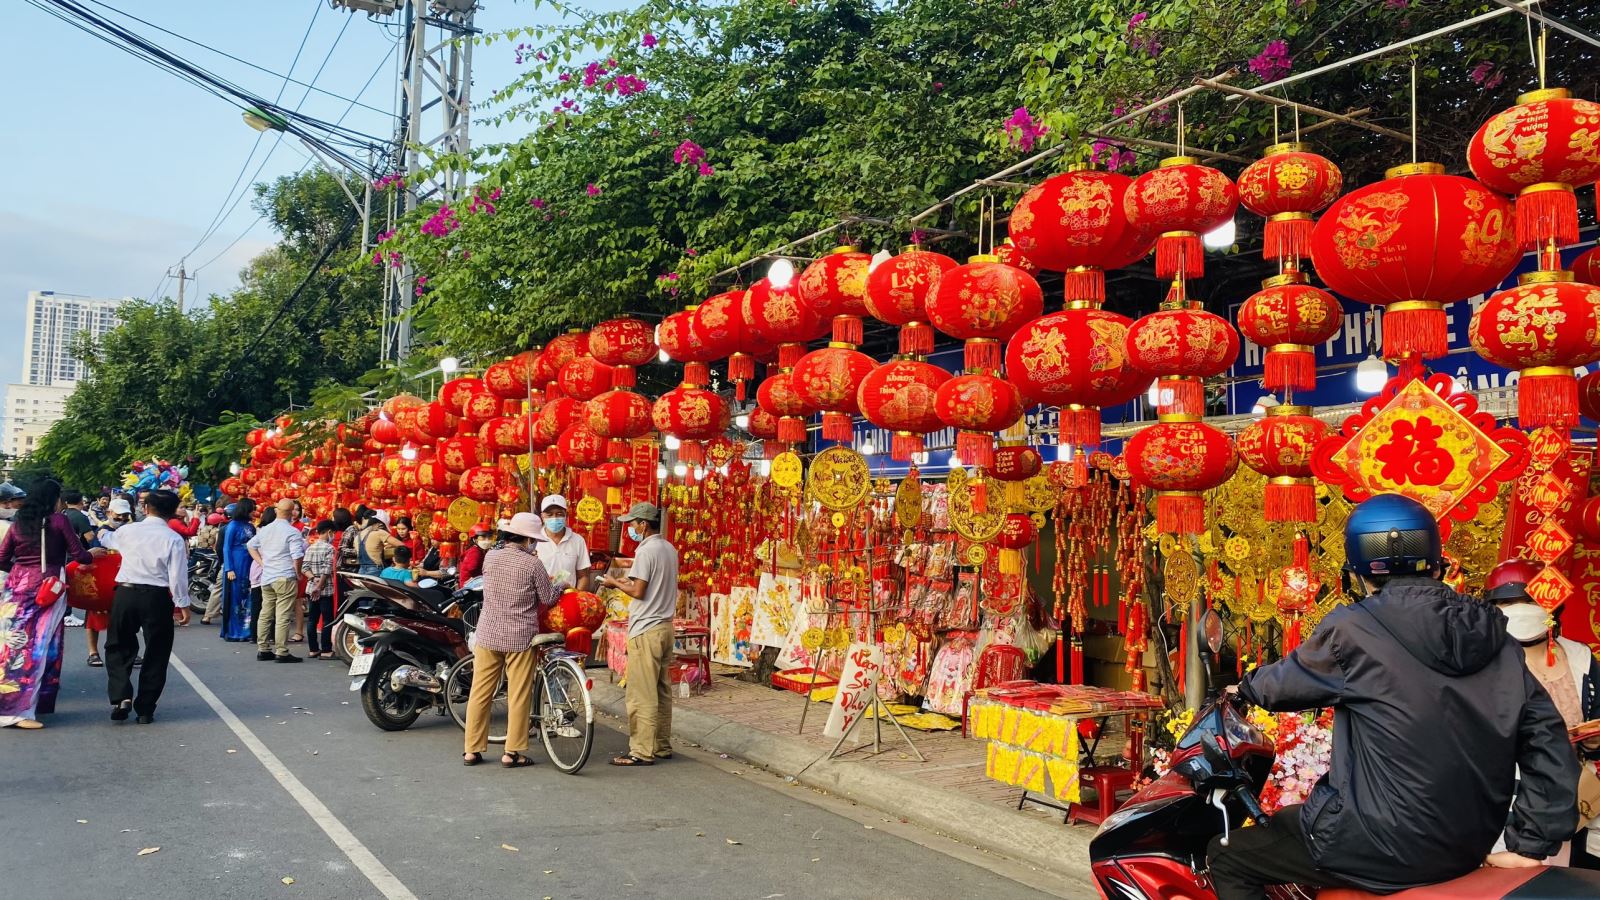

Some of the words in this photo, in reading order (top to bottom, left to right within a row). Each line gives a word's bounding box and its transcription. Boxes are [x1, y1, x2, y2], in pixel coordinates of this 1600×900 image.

[1521, 122, 1549, 132] vượng
[1526, 114, 1549, 123] thịnh
[891, 271, 926, 290] Lộc
[620, 334, 644, 346] Lộc
[569, 437, 592, 452] Lộc
[1533, 436, 1561, 455] Chúc
[1532, 532, 1563, 552] Năm
[1531, 581, 1563, 601] Mới
[846, 671, 873, 691] Sự
